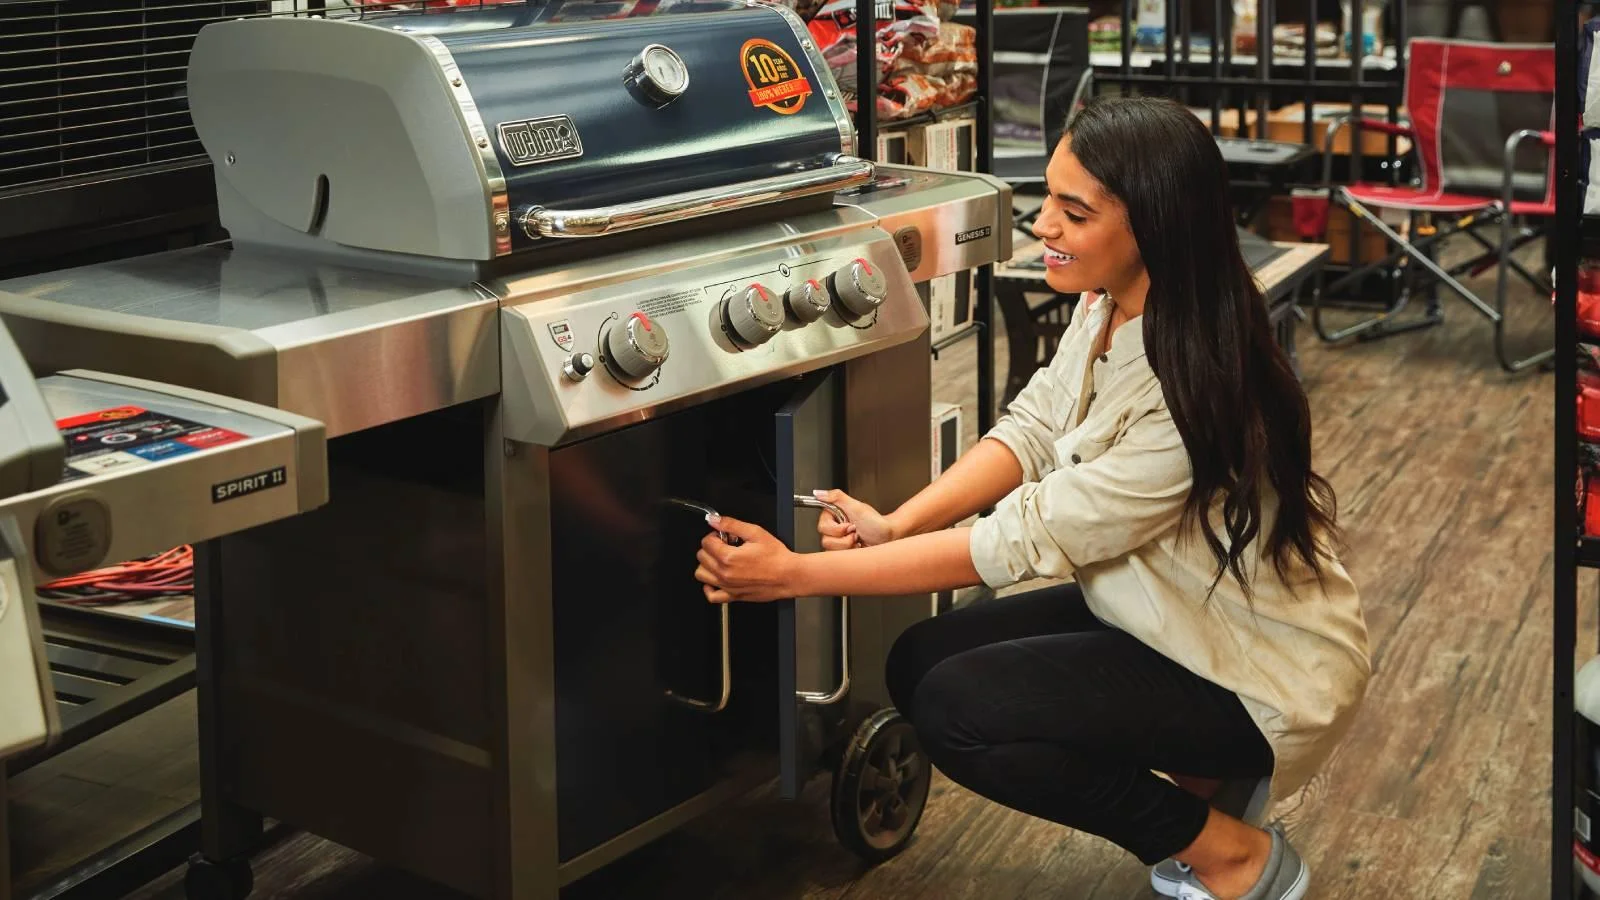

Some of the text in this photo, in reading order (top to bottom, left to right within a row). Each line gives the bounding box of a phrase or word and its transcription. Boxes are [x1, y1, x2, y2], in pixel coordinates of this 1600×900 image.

[749, 53, 780, 83] 10
[755, 88, 774, 102] 100%
[957, 229, 985, 242] GENESIS
[216, 469, 283, 499] SPIRIT II
